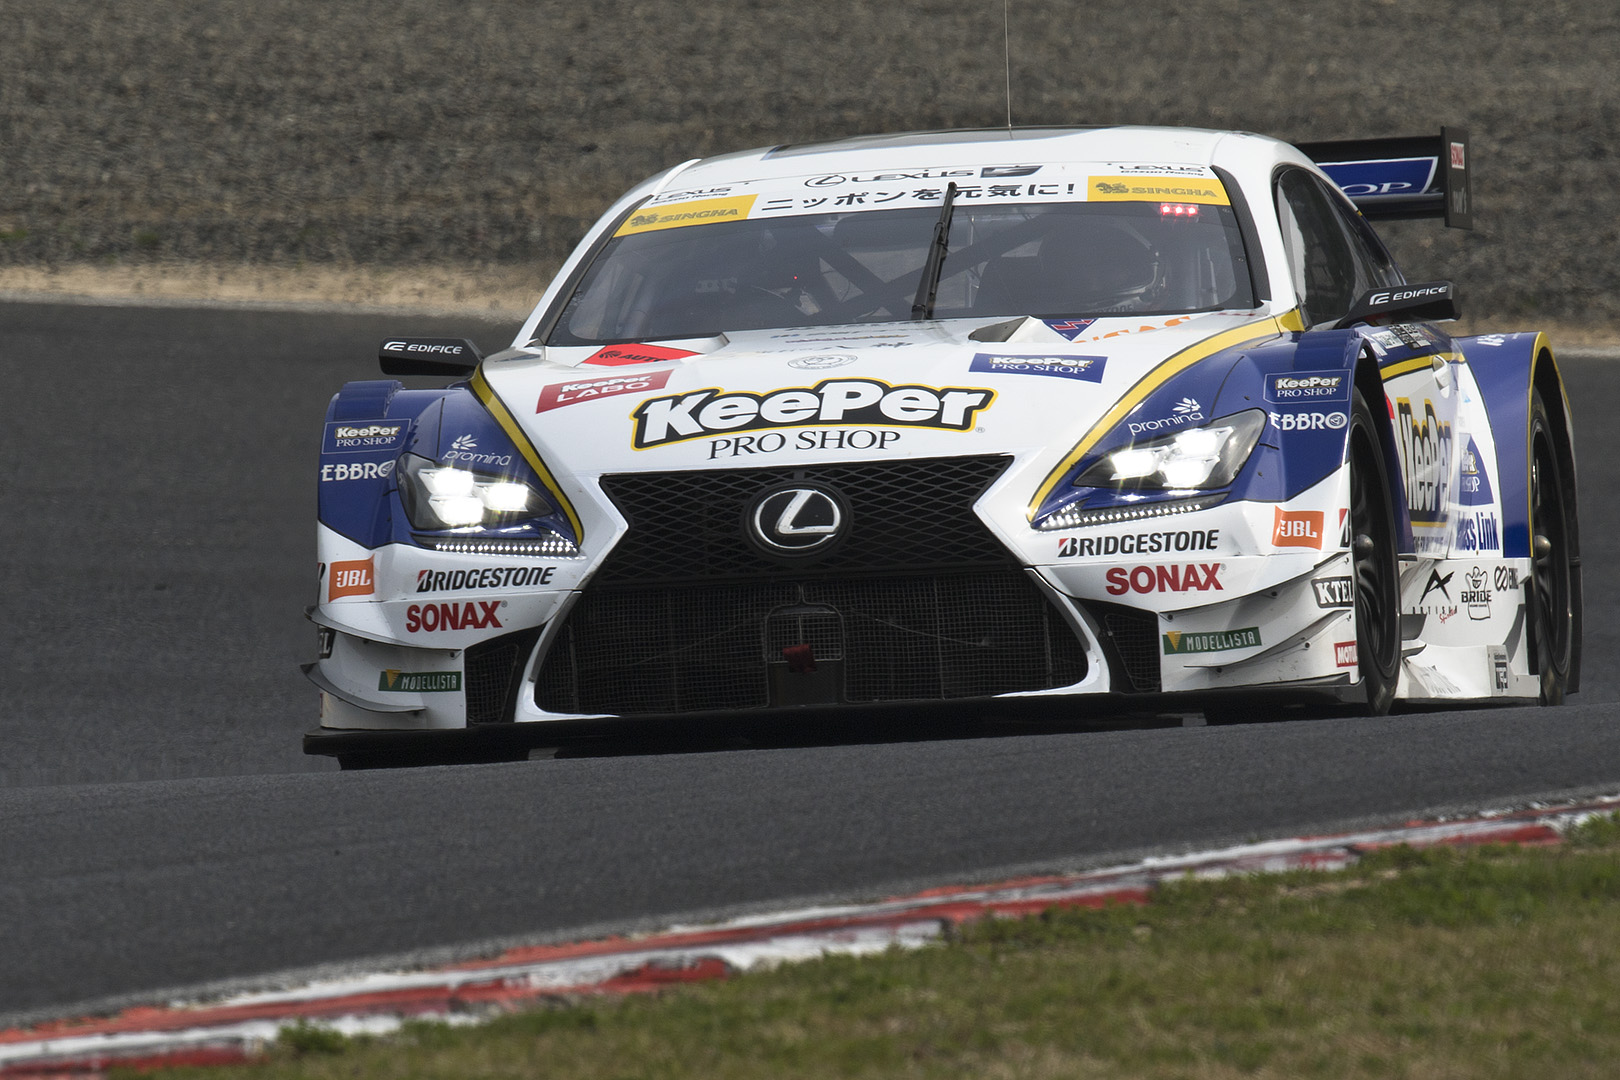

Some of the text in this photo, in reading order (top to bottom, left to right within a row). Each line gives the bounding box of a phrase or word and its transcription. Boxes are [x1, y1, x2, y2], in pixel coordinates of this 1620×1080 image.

[852, 169, 974, 183] LEXUS
[1131, 187, 1217, 198] SINGHA
[658, 209, 738, 223] SINGHA
[1393, 285, 1448, 301] EDIFICE
[407, 344, 463, 355] EDIFICE
[990, 356, 1093, 368] KeePer
[991, 363, 1085, 374] PRO SHOP
[1276, 377, 1341, 389] KeePer
[556, 382, 650, 403] LABO
[1277, 387, 1337, 398] PRO SHOP
[632, 379, 996, 448] KeePer
[1269, 411, 1348, 431] EBBRO
[1127, 410, 1205, 436] promina
[335, 425, 401, 439] KeePer
[336, 436, 396, 447] PRO SHOP
[707, 429, 901, 460] PRO SHOP
[442, 450, 512, 466] promina
[1279, 519, 1318, 538] JBL
[1475, 511, 1500, 551] Link
[1058, 529, 1220, 558] BRIDGESTONE
[336, 569, 371, 588] JBL
[416, 566, 557, 593] BRIDGESTONE
[1105, 563, 1225, 596] SONAX
[1461, 590, 1492, 603] BRIDE
[405, 601, 503, 633] SONAX
[1186, 631, 1256, 651] MODELLISTA
[1336, 647, 1358, 664] MOTU
[401, 673, 457, 690] MODELLISTA
